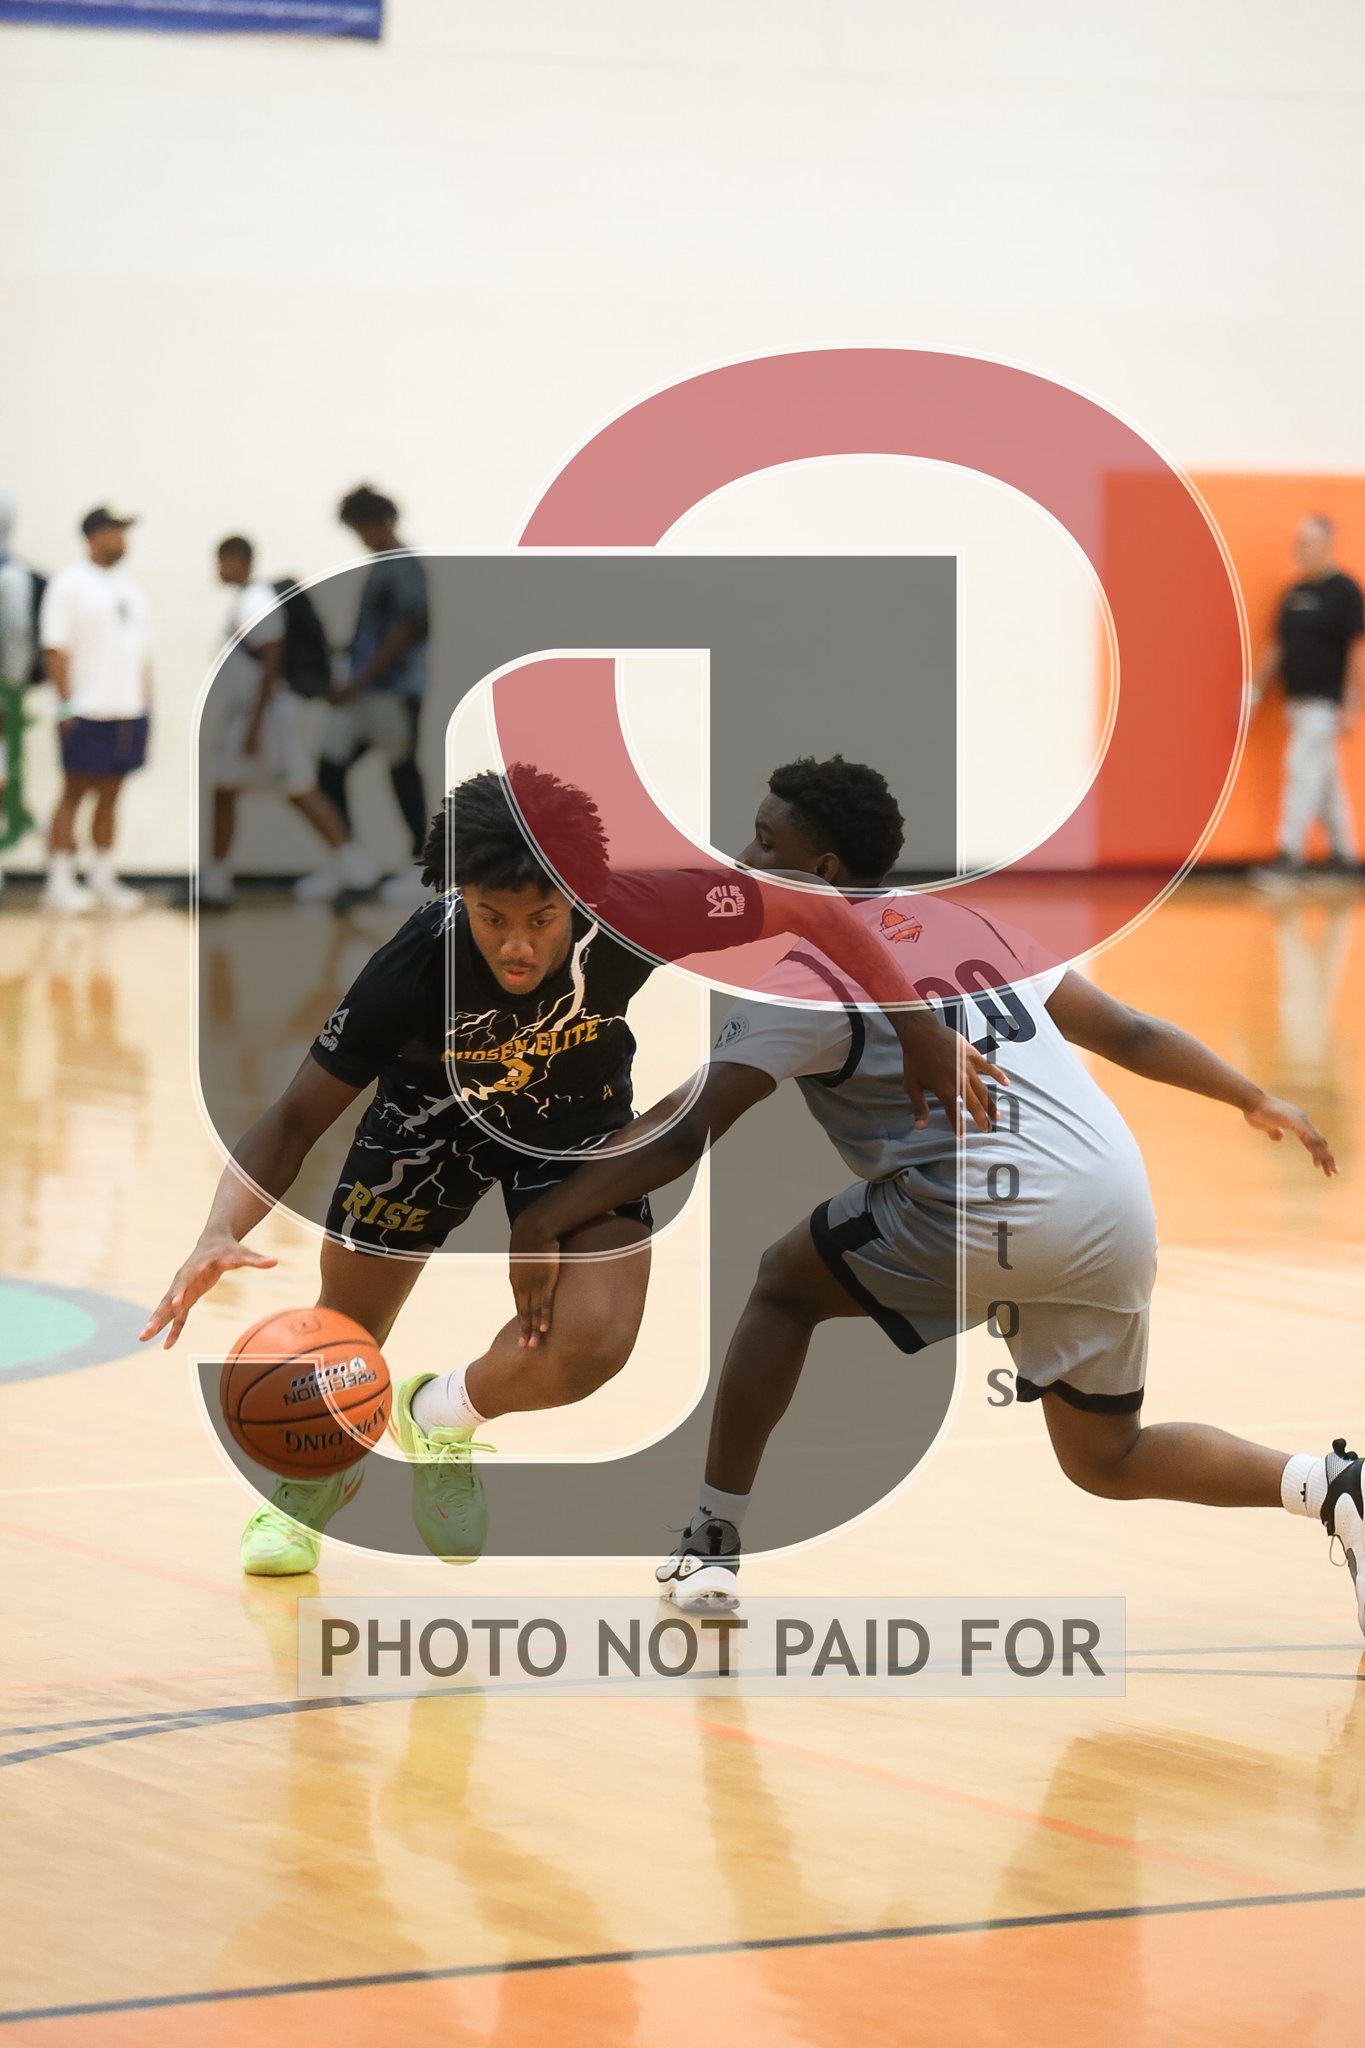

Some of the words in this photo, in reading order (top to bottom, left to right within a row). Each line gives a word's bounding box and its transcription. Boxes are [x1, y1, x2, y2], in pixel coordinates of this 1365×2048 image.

[534, 1018, 600, 1056] ELITE
[493, 1057, 535, 1092] 3
[342, 1180, 431, 1232] RISE
[283, 1370, 377, 1407] PRECISION
